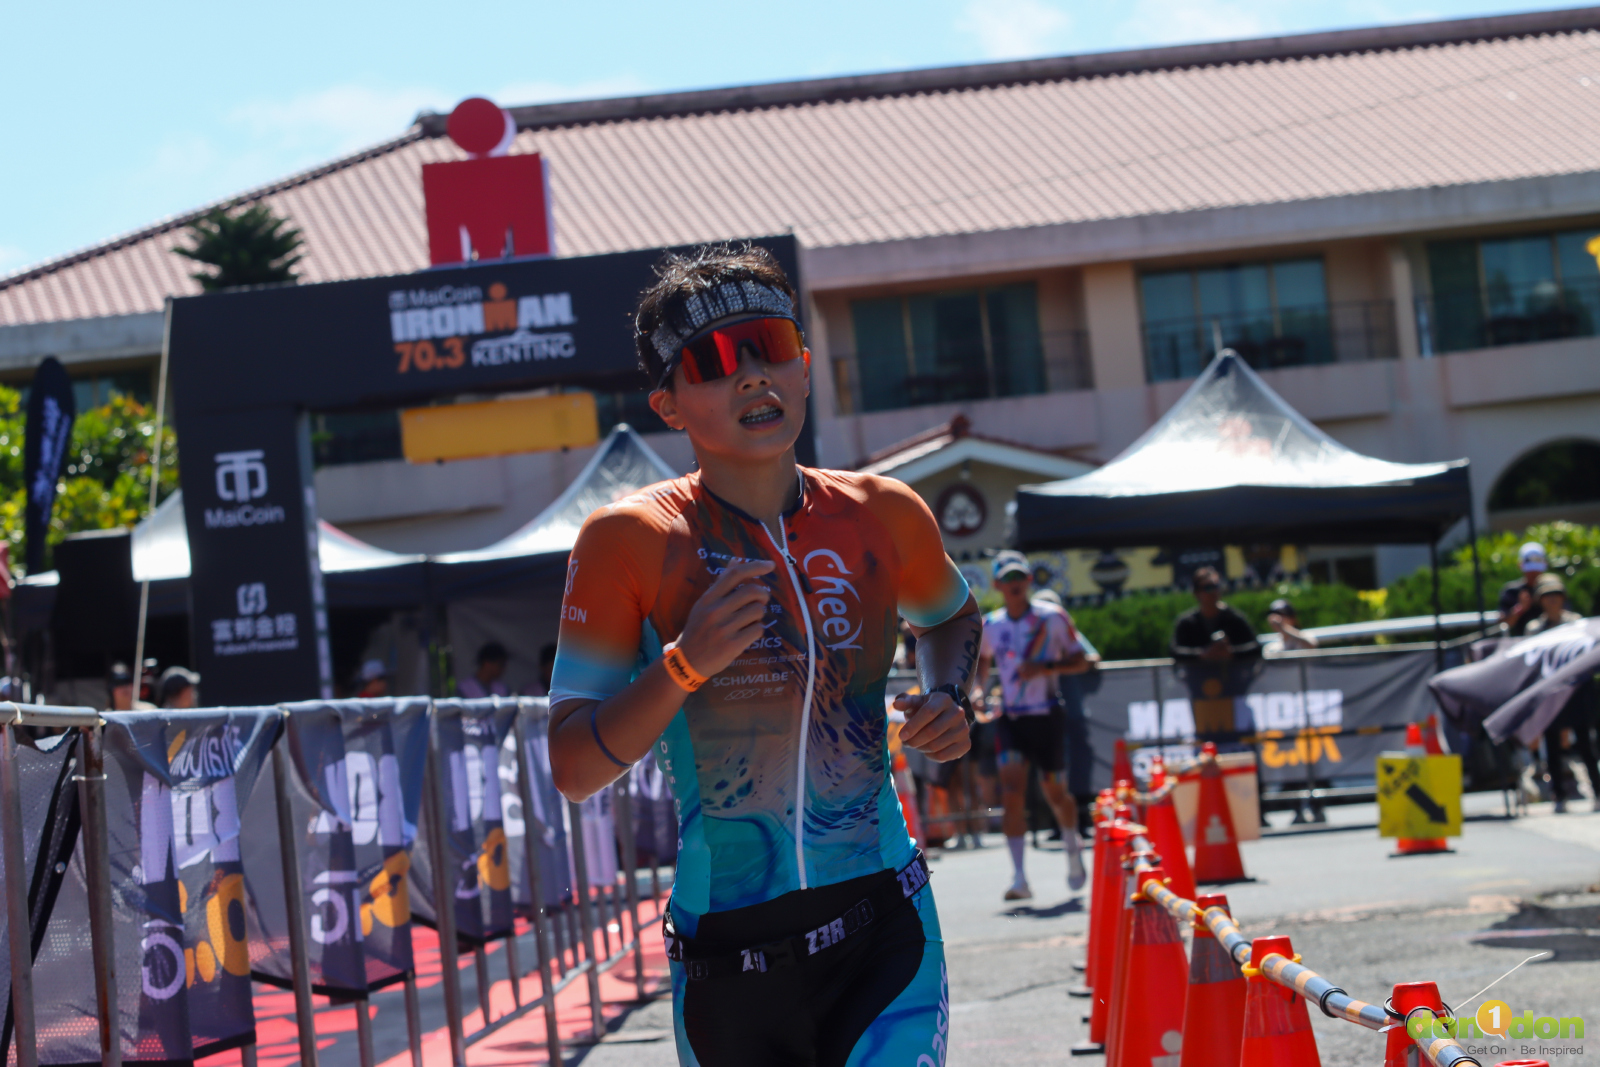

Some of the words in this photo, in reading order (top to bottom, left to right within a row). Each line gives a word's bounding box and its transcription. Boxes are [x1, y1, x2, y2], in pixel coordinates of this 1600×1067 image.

[389, 286, 575, 342] IRONMAN
[394, 337, 465, 373] 70.3
[471, 334, 576, 367] KENTING
[205, 505, 285, 528] MaiCoin
[712, 671, 789, 688] SCHWALBE
